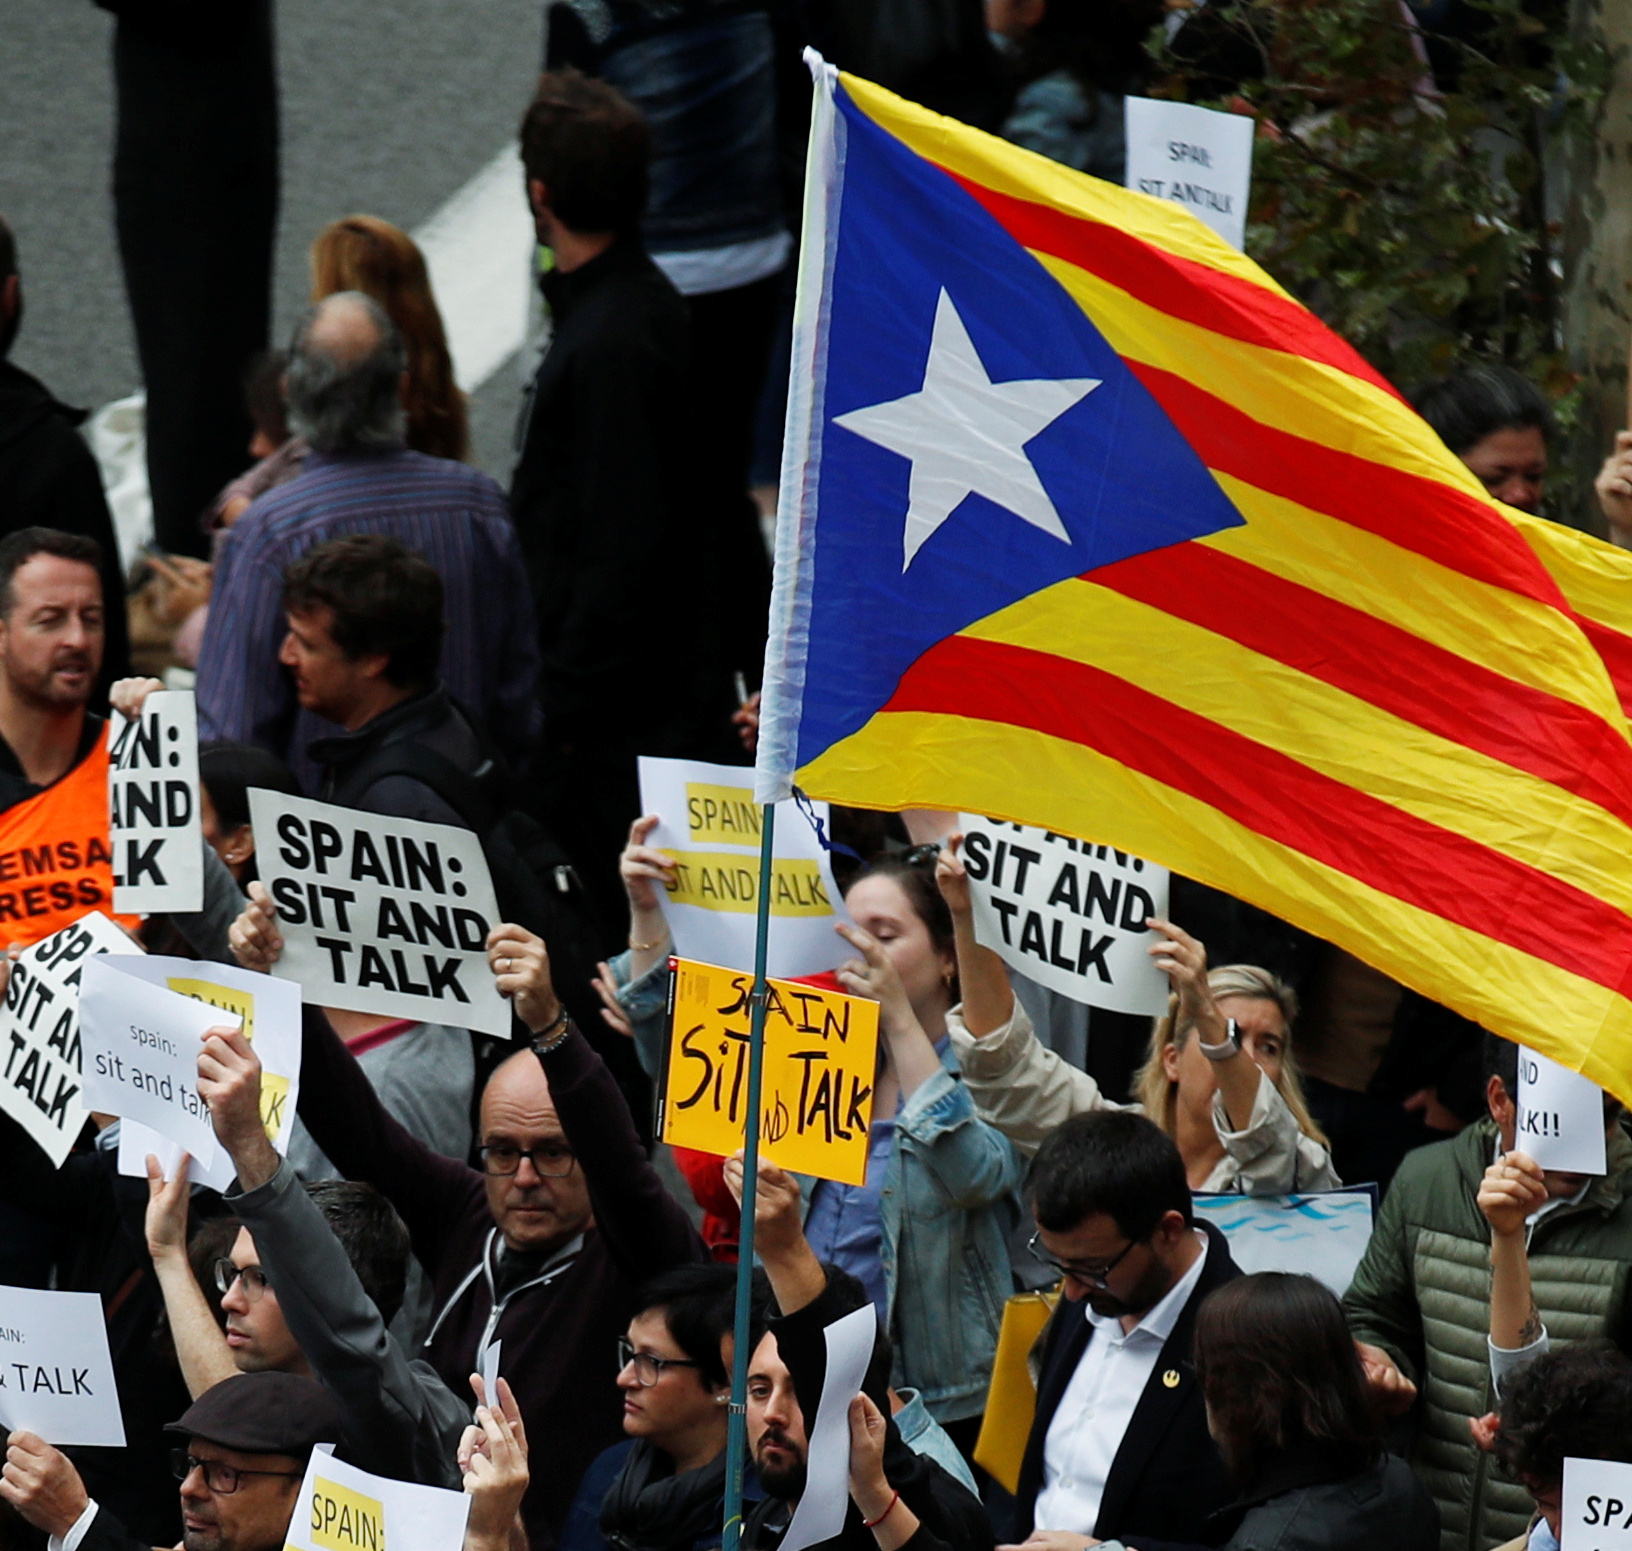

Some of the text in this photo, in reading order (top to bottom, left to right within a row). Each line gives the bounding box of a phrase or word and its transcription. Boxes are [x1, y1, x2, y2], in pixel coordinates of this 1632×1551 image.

[277, 814, 465, 897] SPAIN:
[701, 867, 755, 902] AND
[759, 871, 831, 906] ALK
[964, 831, 1042, 896] SIT
[1048, 863, 1156, 935] AND
[271, 878, 489, 954] SIT AND
[990, 899, 1118, 986] TALK
[7, 963, 56, 1032] SIT
[316, 937, 471, 1004] TALK
[96, 1050, 126, 1082] sit
[131, 1067, 174, 1103] and
[130, 1025, 178, 1057] spain:
[3, 1028, 82, 1131] TALK
[788, 1051, 872, 1144] TALK
[11, 1363, 95, 1397] TALK
